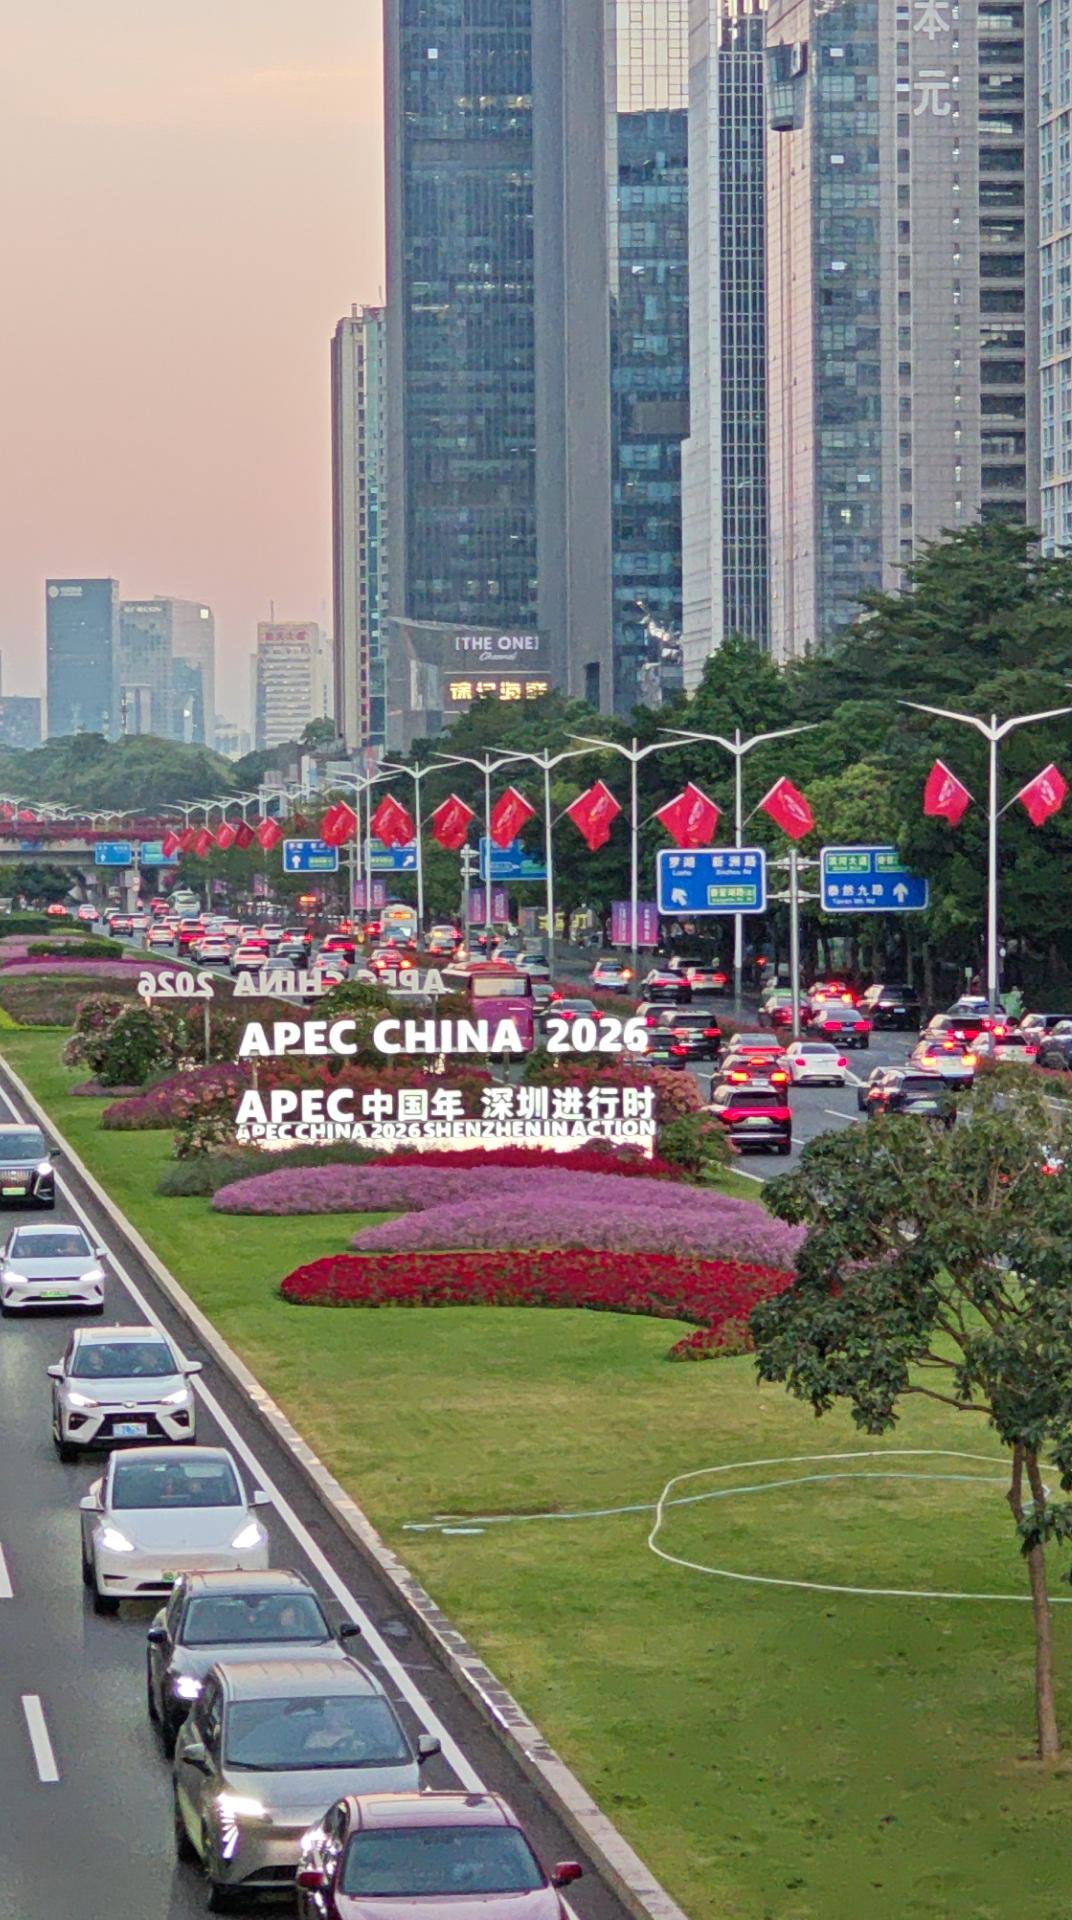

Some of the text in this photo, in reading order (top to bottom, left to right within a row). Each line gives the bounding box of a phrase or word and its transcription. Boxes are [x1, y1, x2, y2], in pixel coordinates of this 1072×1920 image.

[913, 0, 951, 116] 本元
[239, 1017, 649, 1056] APEC CHINA 2026
[480, 1085, 656, 1121] 深圳进行时
[236, 1119, 656, 1140] APEC CHINA 2026 SHENZHEN IN ACTION
